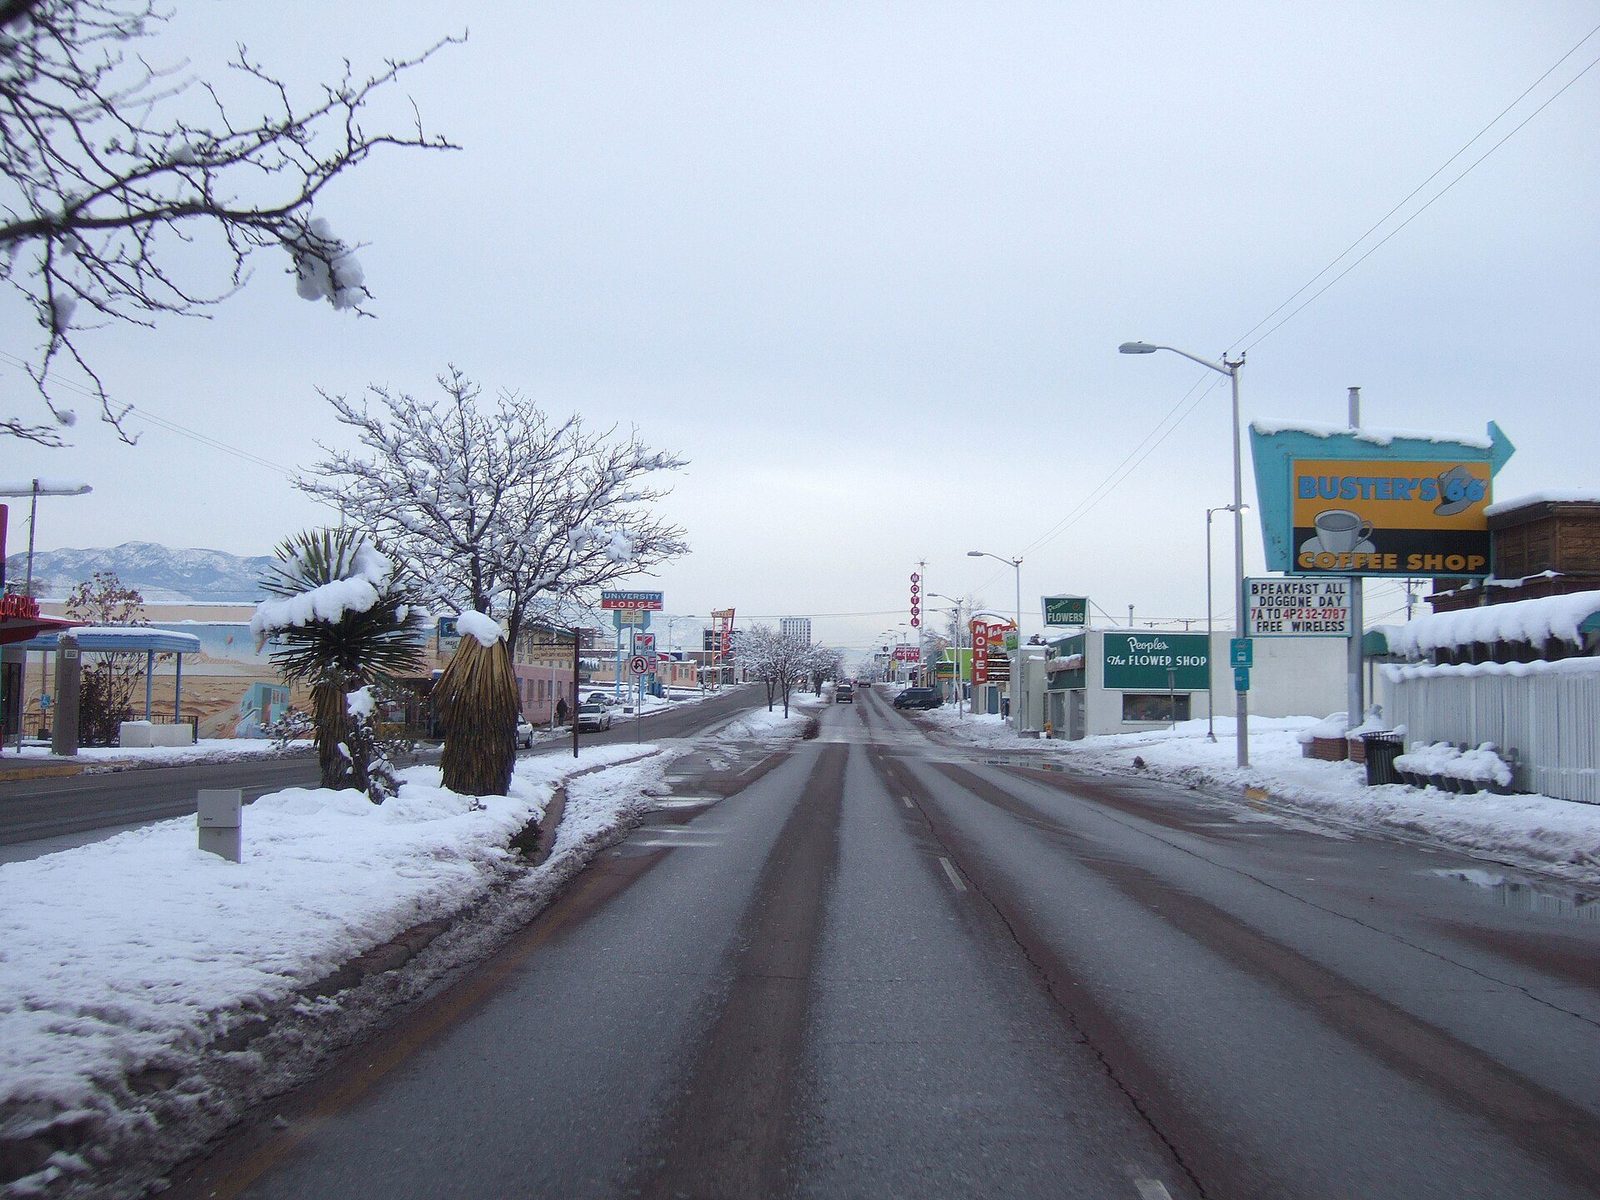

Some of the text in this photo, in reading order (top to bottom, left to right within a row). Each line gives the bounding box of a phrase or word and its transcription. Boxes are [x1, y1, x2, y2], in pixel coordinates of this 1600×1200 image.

[1297, 476, 1486, 502] BUSTER'S 66
[1297, 551, 1486, 571] COFFEE SHOP
[1325, 583, 1346, 594] ALL
[603, 592, 661, 600] UNIVERSITY
[910, 573, 919, 626] MOTEL
[1259, 596, 1343, 607] DOGGONE DAY
[610, 601, 655, 609] LODGE
[1047, 612, 1084, 622] FLOWERS
[1251, 608, 1263, 620] 7A
[1266, 608, 1281, 619] TO
[1283, 608, 1297, 620] 4P
[1256, 621, 1345, 632] FREE WIRELESS
[1127, 636, 1170, 653] Peoples
[975, 624, 986, 682] MOTEL
[1106, 655, 1126, 666] The
[1175, 655, 1207, 667] SHOP
